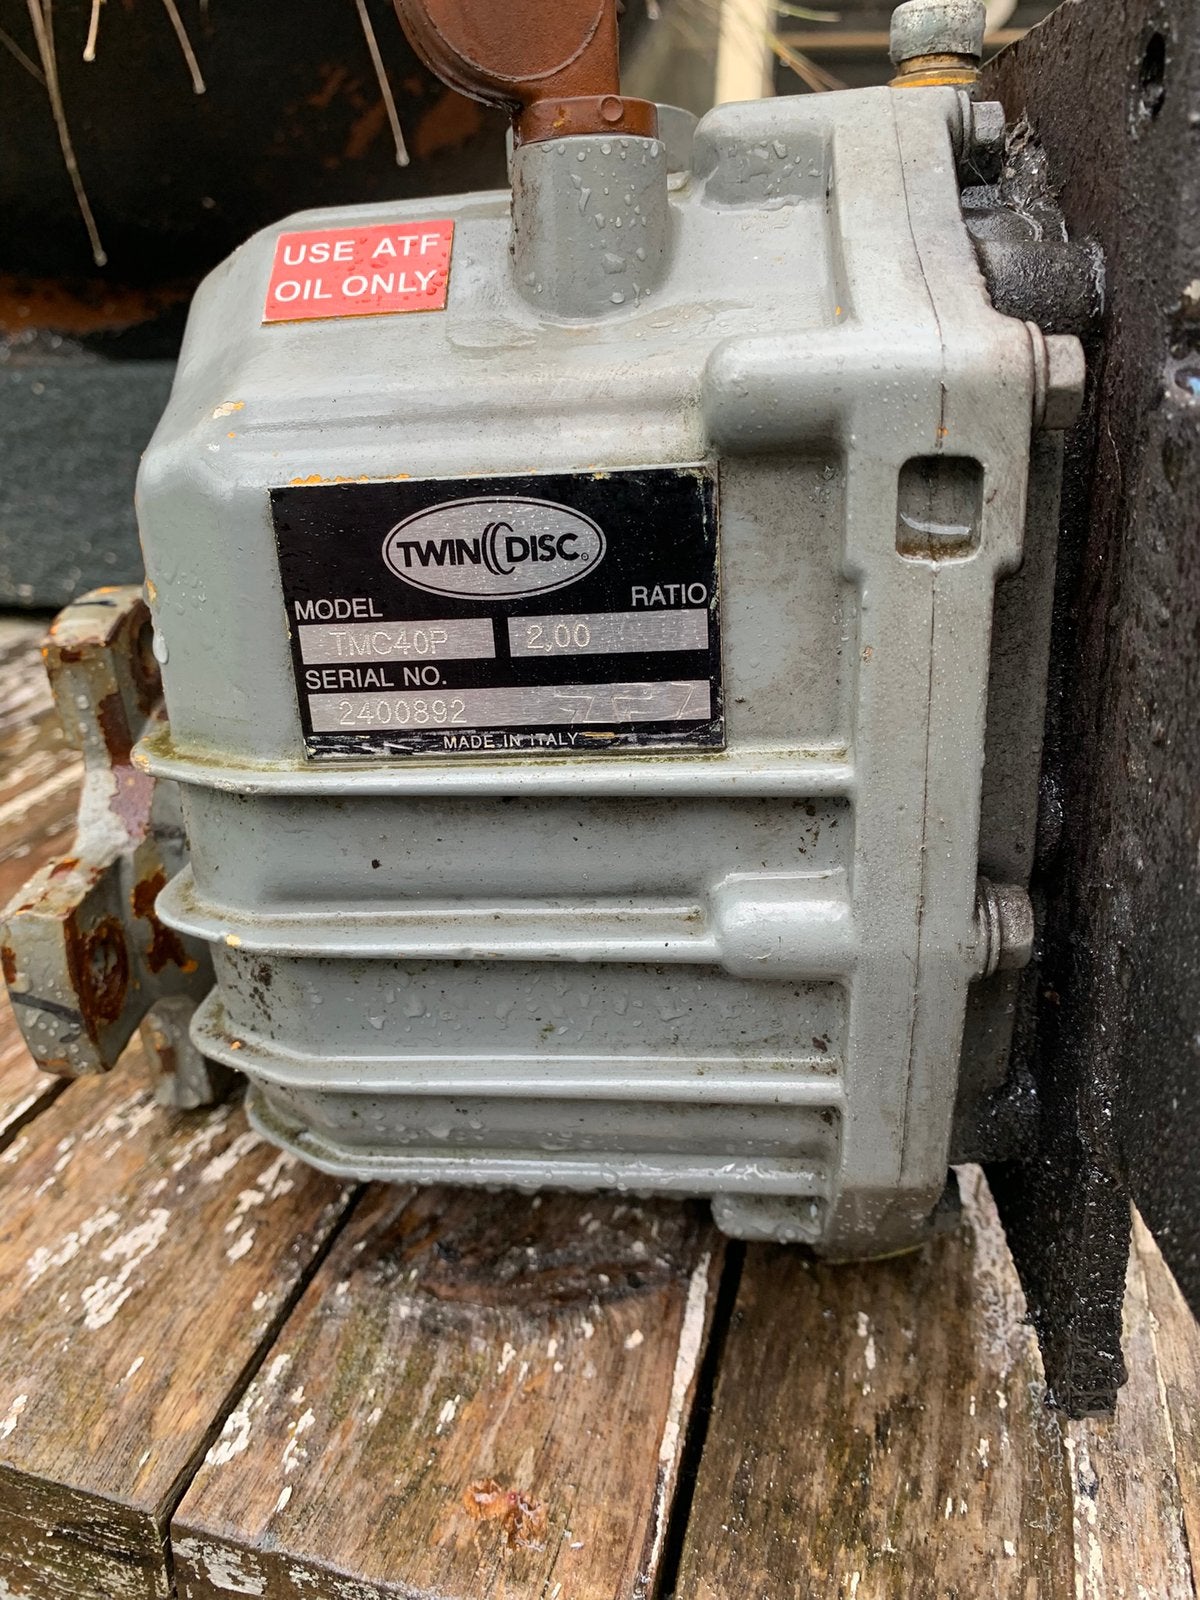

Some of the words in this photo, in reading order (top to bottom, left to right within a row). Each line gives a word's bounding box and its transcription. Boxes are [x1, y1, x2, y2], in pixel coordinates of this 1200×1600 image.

[283, 240, 355, 266] USE
[371, 233, 441, 259] ATF
[274, 278, 332, 302] OIL
[341, 269, 437, 297] ONLY
[396, 537, 480, 568] TWIN
[631, 582, 708, 607] RATIO
[294, 597, 384, 620] MODEL
[329, 629, 449, 656] TMC40P
[526, 623, 591, 652] 2,00
[304, 667, 394, 690] SERIAL
[403, 665, 447, 686] NO.
[339, 698, 468, 726] 2400892
[443, 734, 496, 750] MADE
[503, 733, 521, 748] IN
[530, 731, 579, 747] ITALY
